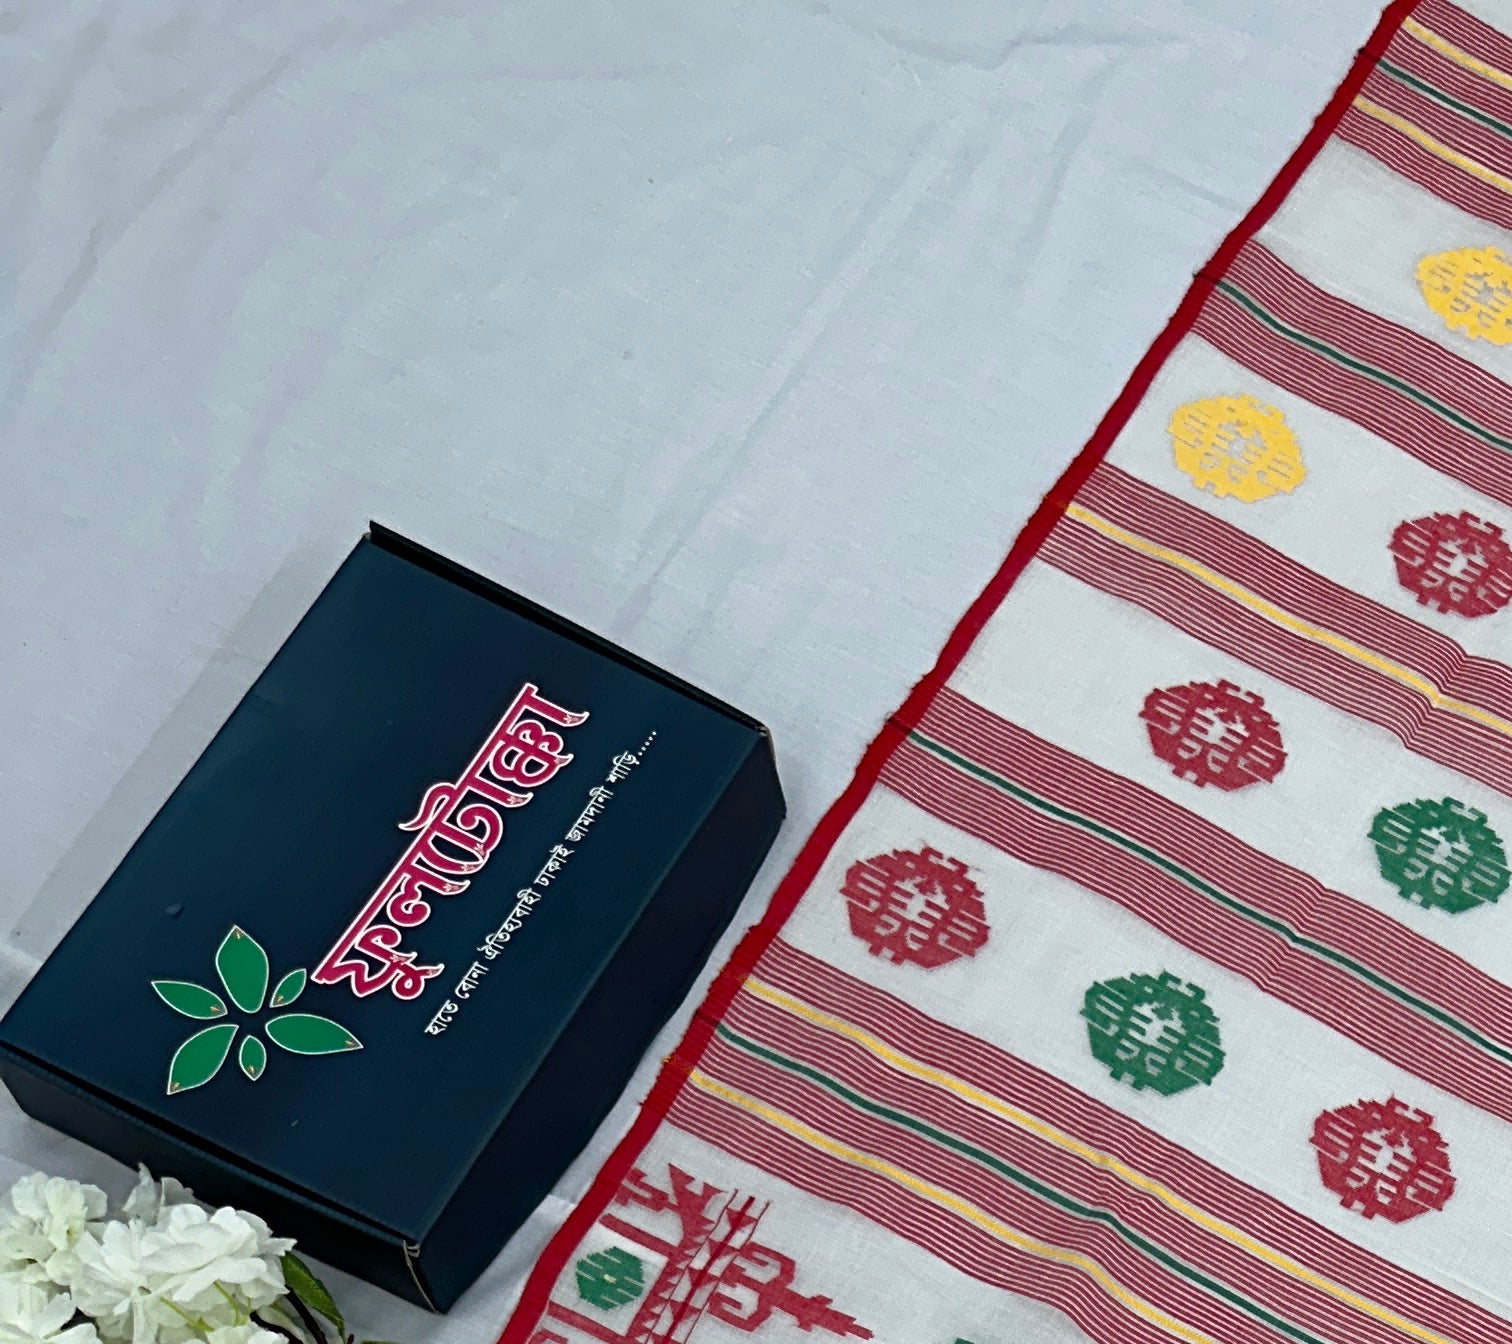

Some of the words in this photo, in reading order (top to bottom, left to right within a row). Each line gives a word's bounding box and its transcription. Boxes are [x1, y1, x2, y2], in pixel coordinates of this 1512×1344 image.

[311, 682, 590, 1001] ফুলটোক্কা
[424, 1000, 459, 1035] হাতে
[455, 961, 490, 999] বোনা
[477, 887, 542, 960] ঐতিহ্যবাহী
[534, 844, 575, 886] ঢাকাই
[565, 786, 614, 842] জামদানী
